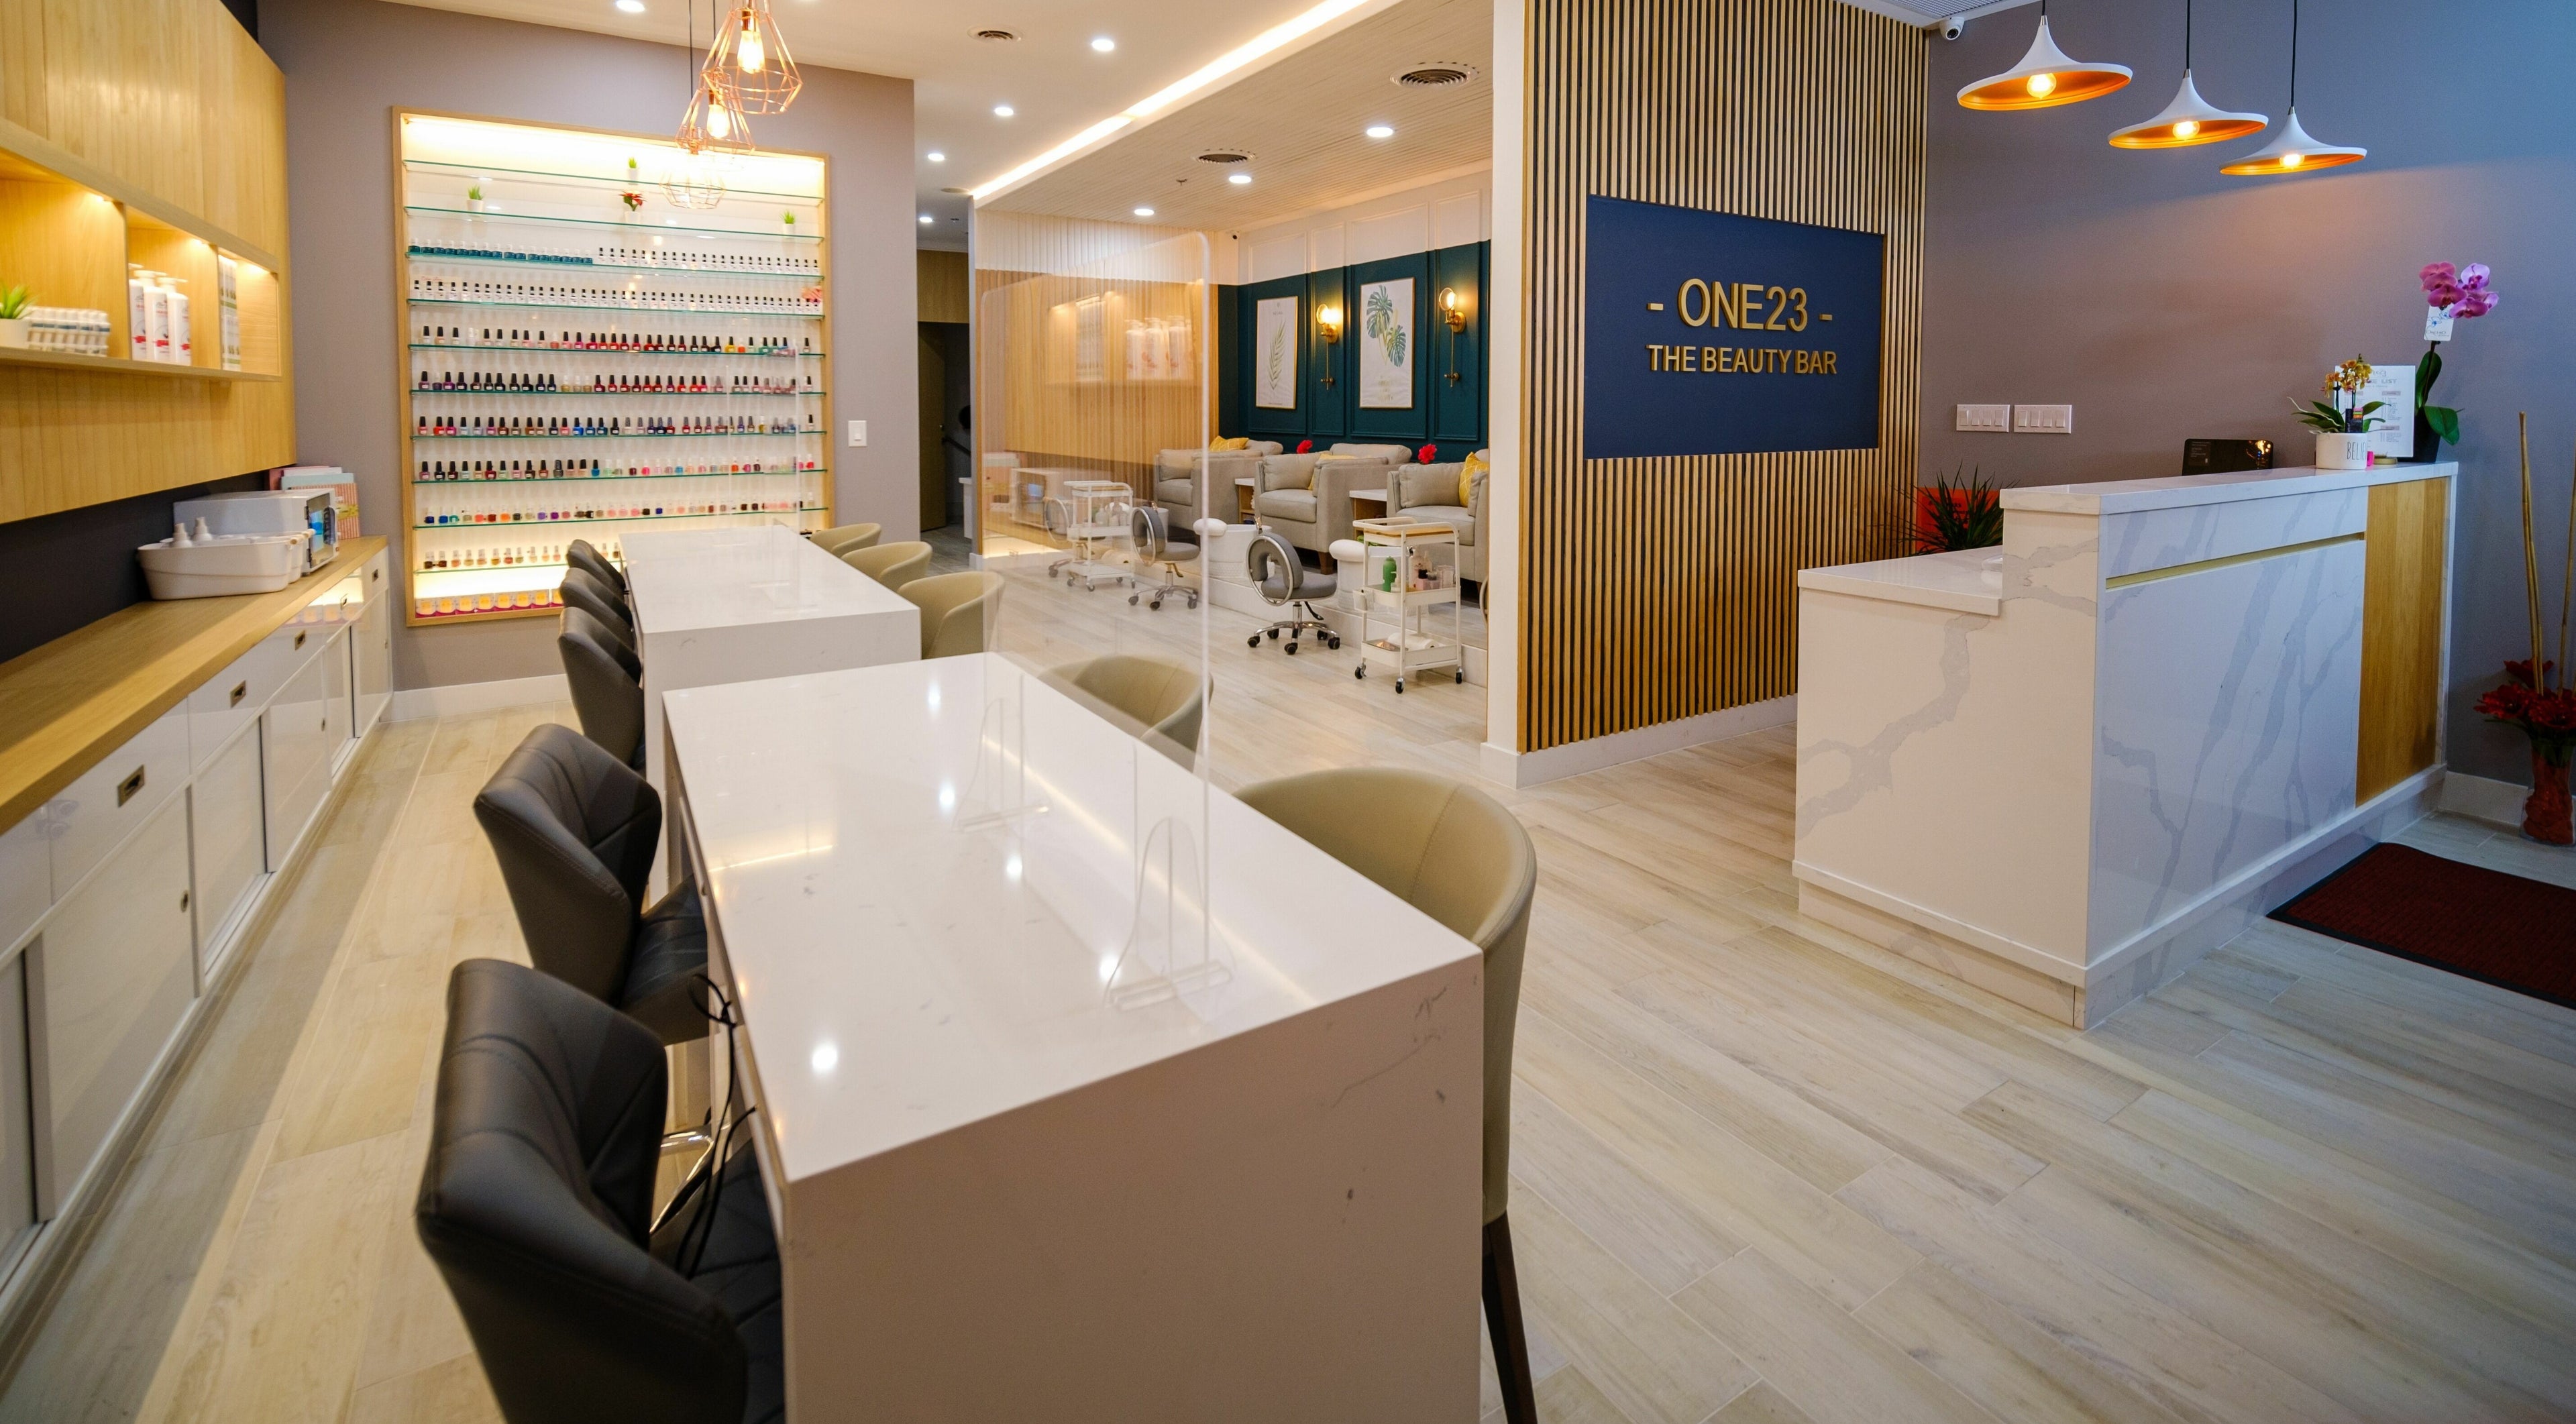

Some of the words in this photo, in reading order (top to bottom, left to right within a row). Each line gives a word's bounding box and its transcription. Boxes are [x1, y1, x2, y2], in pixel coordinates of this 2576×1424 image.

[1678, 278, 1808, 331] ONE23
[1646, 344, 1697, 372] THE
[1701, 347, 1792, 374] BEAUTY
[1794, 349, 1837, 374] BAR
[2347, 441, 2366, 461] BELIE
